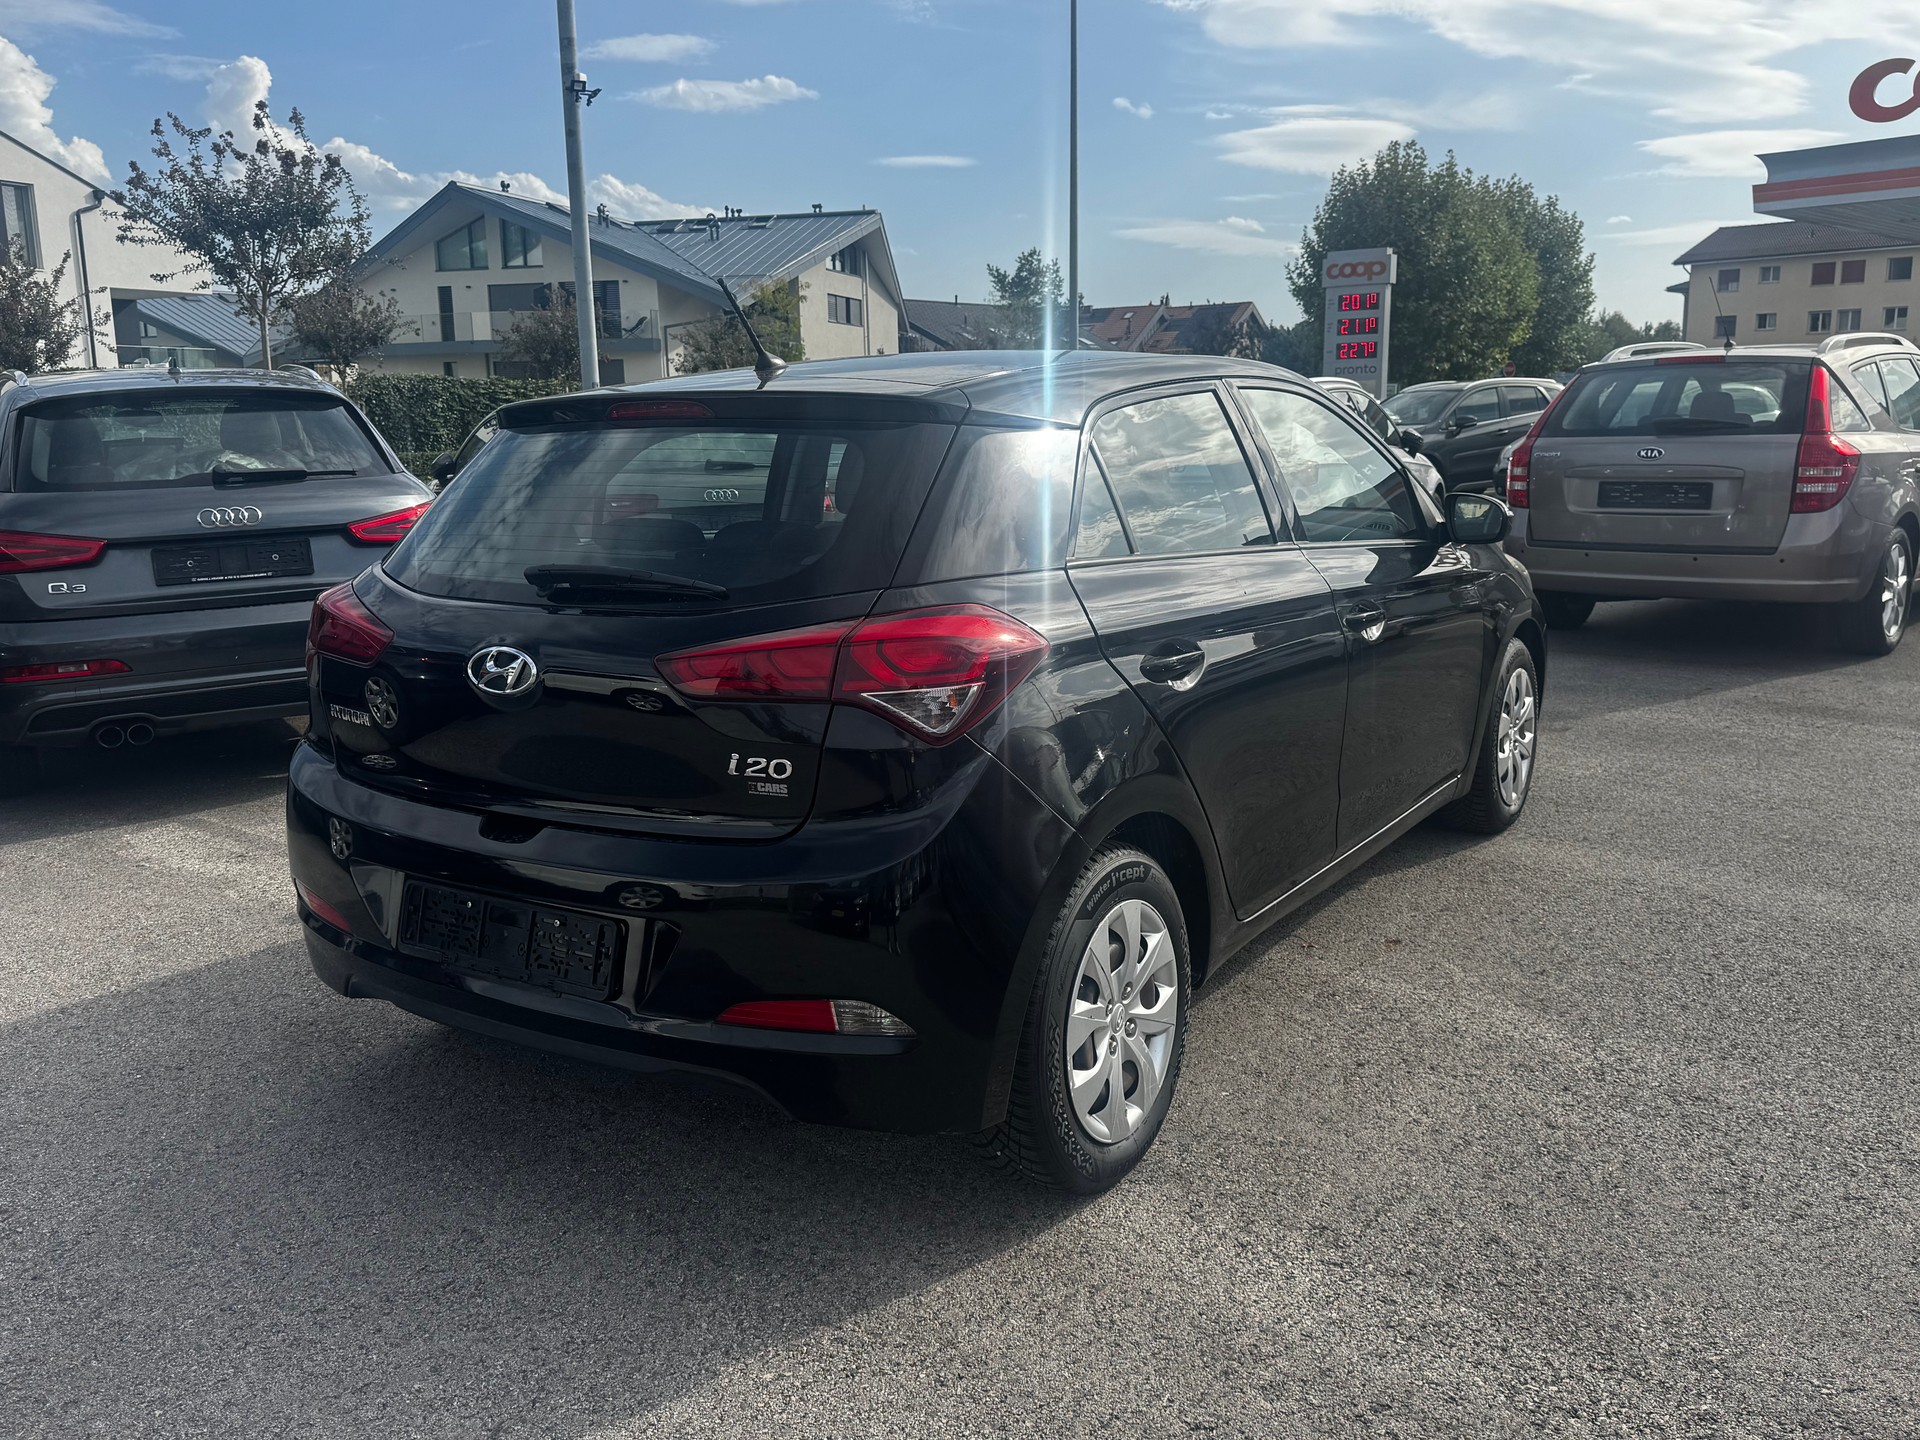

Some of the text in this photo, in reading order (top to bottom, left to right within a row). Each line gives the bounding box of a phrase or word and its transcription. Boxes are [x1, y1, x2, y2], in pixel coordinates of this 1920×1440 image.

[1326, 261, 1386, 281] coop
[1335, 364, 1377, 376] pronto
[1640, 449, 1659, 458] KIA
[48, 582, 86, 594] Q3
[330, 703, 371, 727] HYUNDAI
[728, 753, 793, 779] i20
